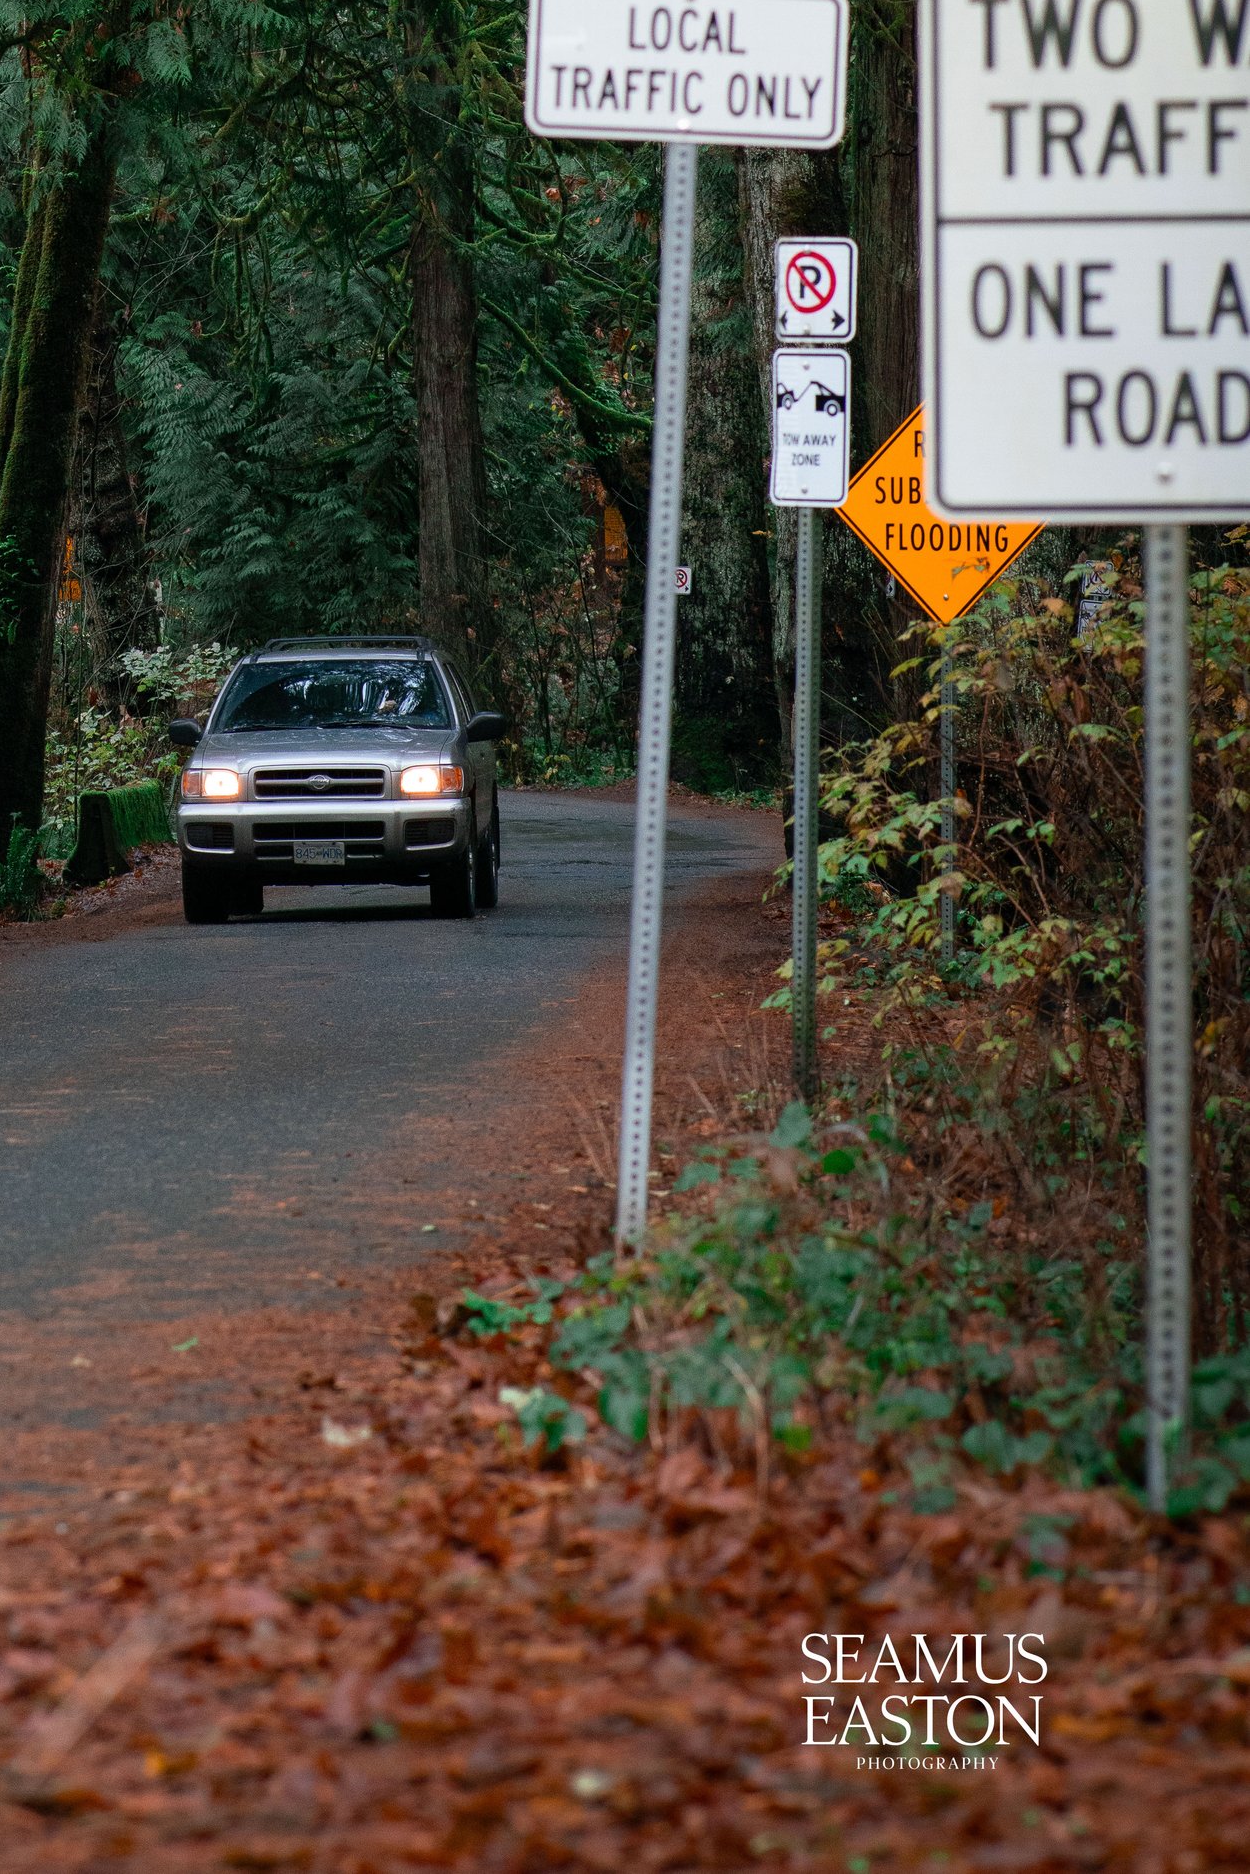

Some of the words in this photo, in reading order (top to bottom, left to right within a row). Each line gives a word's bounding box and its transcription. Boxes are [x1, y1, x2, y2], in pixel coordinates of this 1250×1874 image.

[629, 6, 747, 55] LOCAL
[552, 64, 703, 115] TRAFFIC
[728, 72, 822, 120] ONLY
[970, 261, 1114, 340] ONE
[1063, 369, 1250, 447] ROAD
[803, 434, 836, 446] AWAY
[791, 453, 821, 467] ZONE
[875, 477, 923, 505] SUB
[885, 523, 1009, 553] FLOODING
[295, 848, 316, 859] 845
